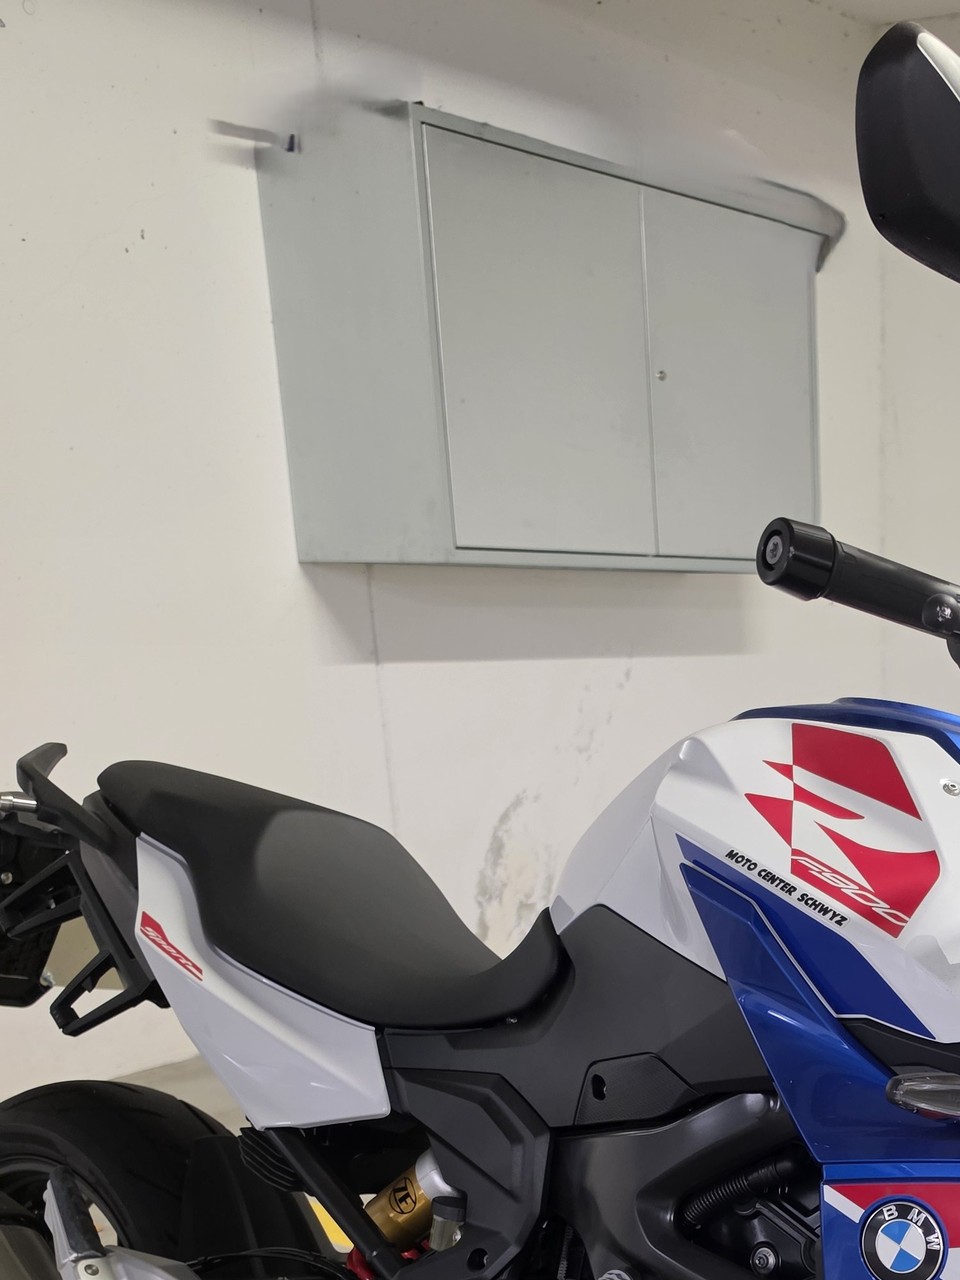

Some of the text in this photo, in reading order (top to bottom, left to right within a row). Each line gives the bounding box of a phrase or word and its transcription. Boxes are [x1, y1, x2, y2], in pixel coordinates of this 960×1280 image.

[725, 849, 848, 927] MOTO CENTER SCHWYZ
[882, 1204, 941, 1250] BMW
